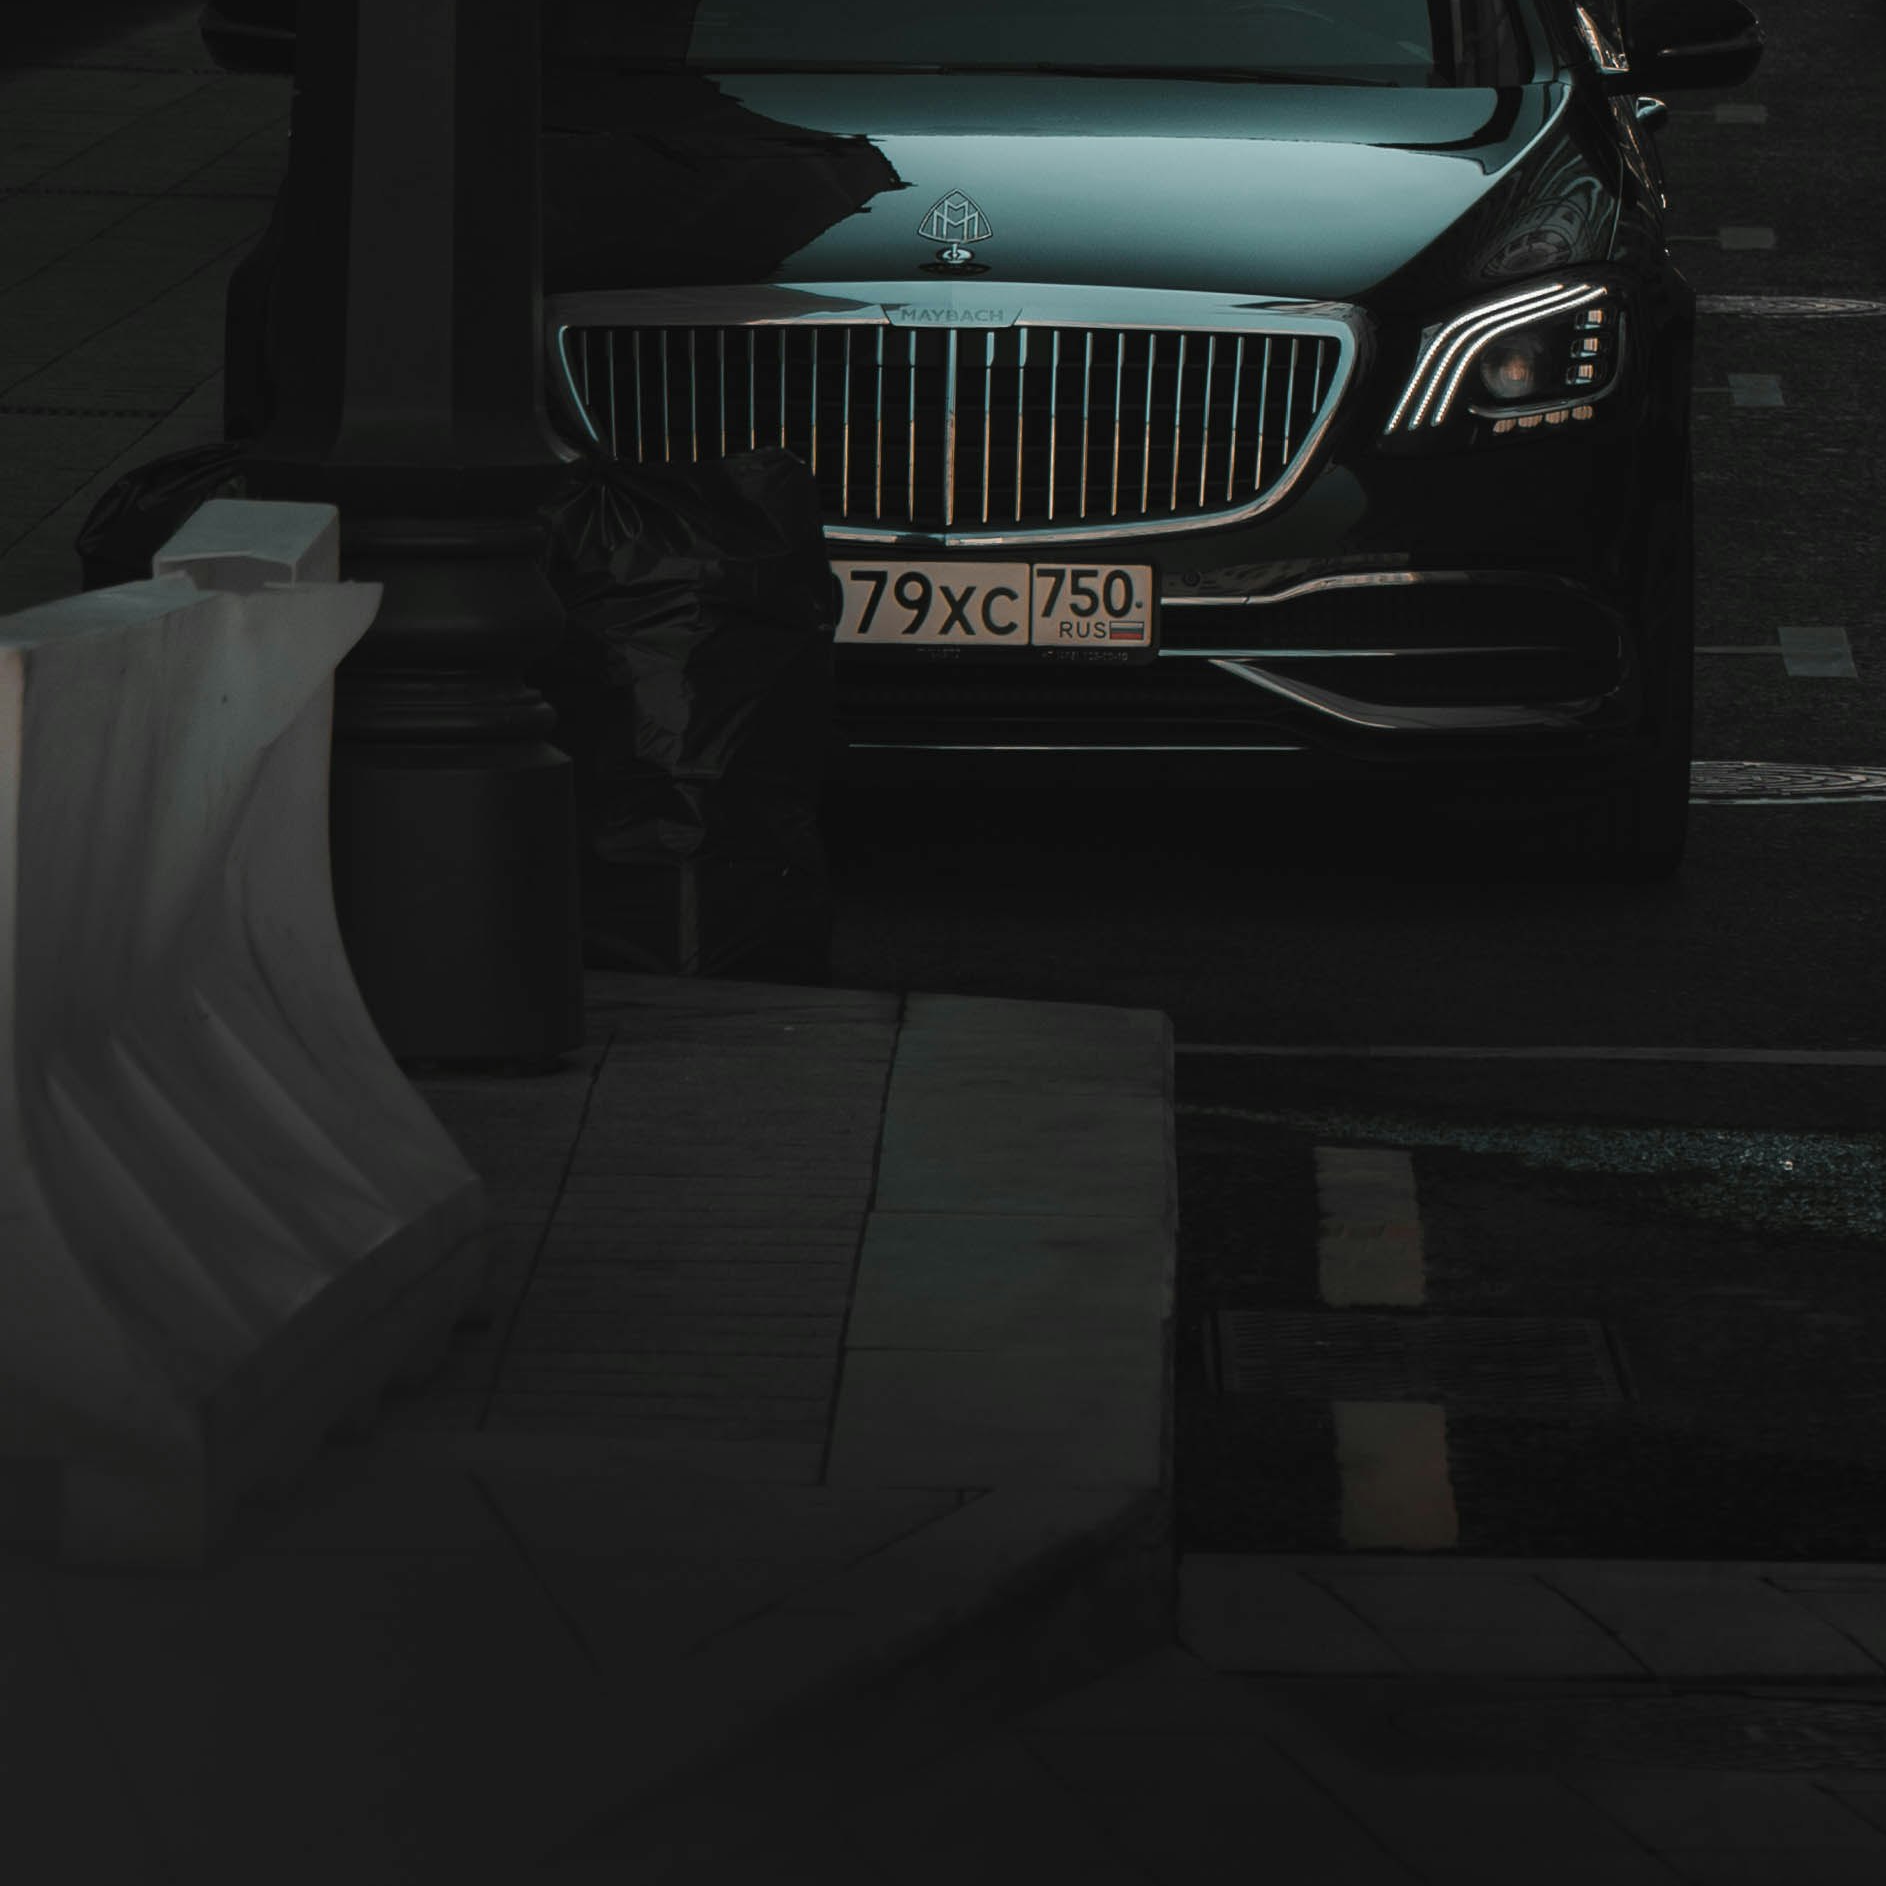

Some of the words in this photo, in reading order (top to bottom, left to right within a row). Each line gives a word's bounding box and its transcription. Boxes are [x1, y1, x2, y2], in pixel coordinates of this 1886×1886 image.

[901, 308, 1004, 323] MAYBACH
[1036, 568, 1134, 618] 750
[1058, 622, 1107, 639] RUS
